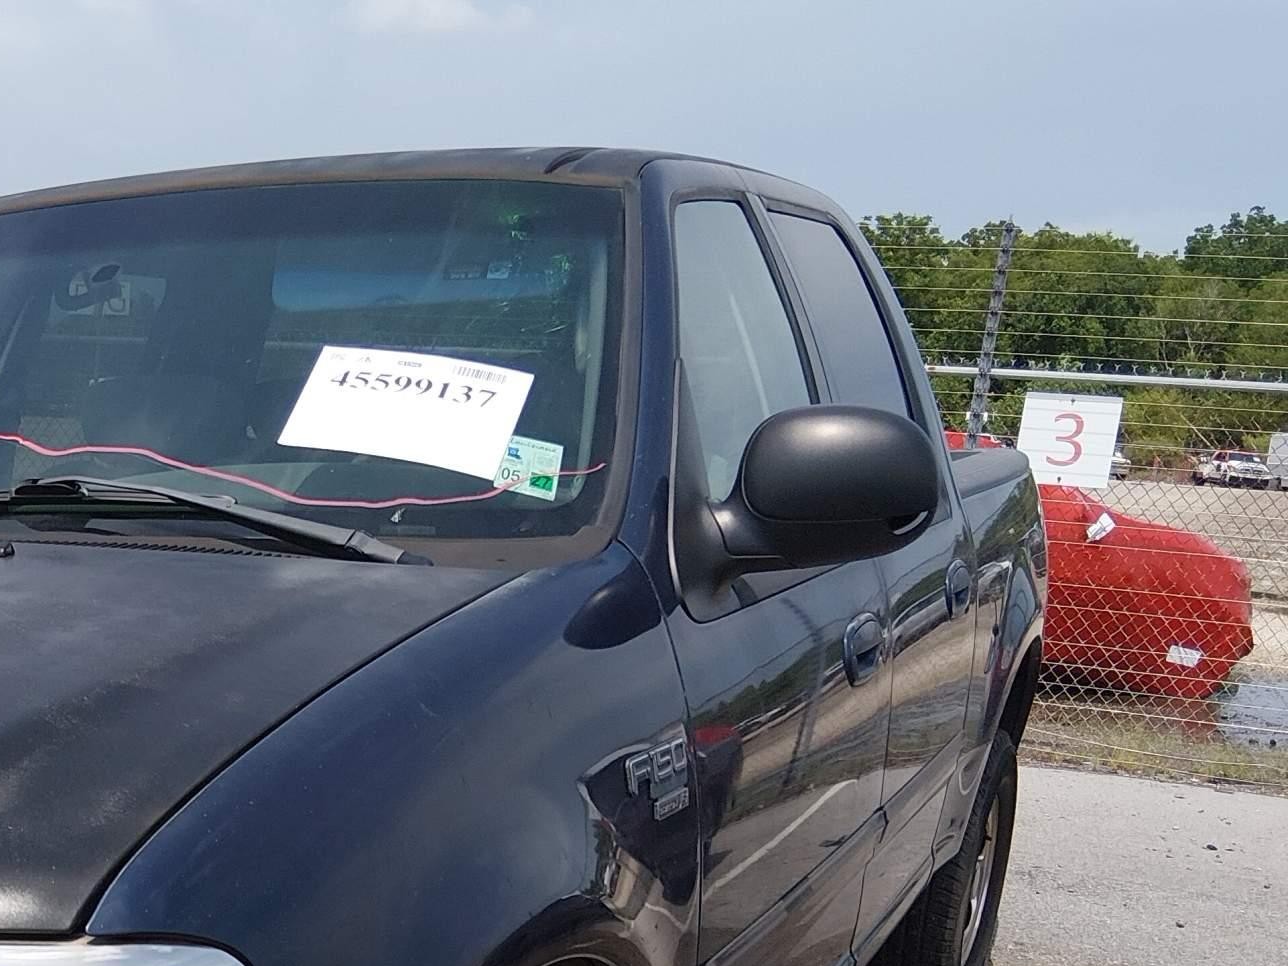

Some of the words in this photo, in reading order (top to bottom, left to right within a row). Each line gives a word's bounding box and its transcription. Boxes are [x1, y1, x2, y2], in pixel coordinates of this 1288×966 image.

[331, 370, 497, 408] 45599137
[1046, 413, 1085, 467] 3
[501, 467, 521, 482] 05
